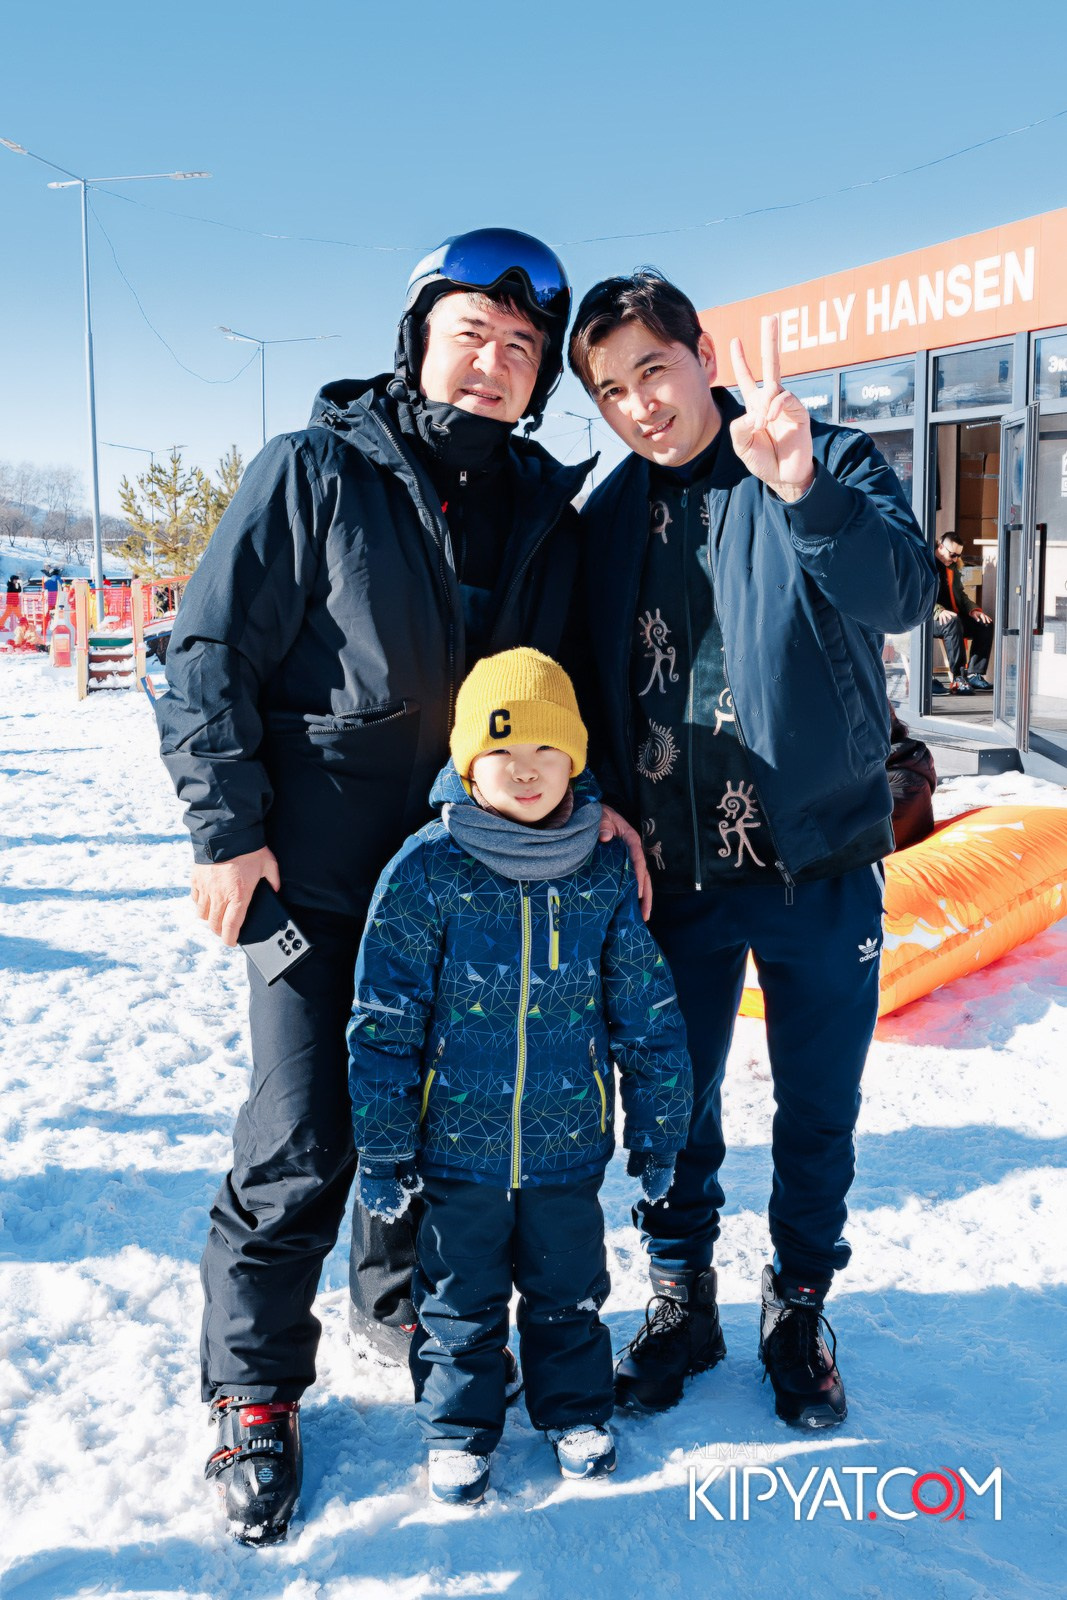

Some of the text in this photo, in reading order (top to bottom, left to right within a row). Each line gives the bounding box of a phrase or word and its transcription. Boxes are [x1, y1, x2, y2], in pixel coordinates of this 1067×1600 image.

[865, 246, 1035, 336] HANSEN
[489, 709, 511, 739] C
[859, 950, 879, 963] adidas
